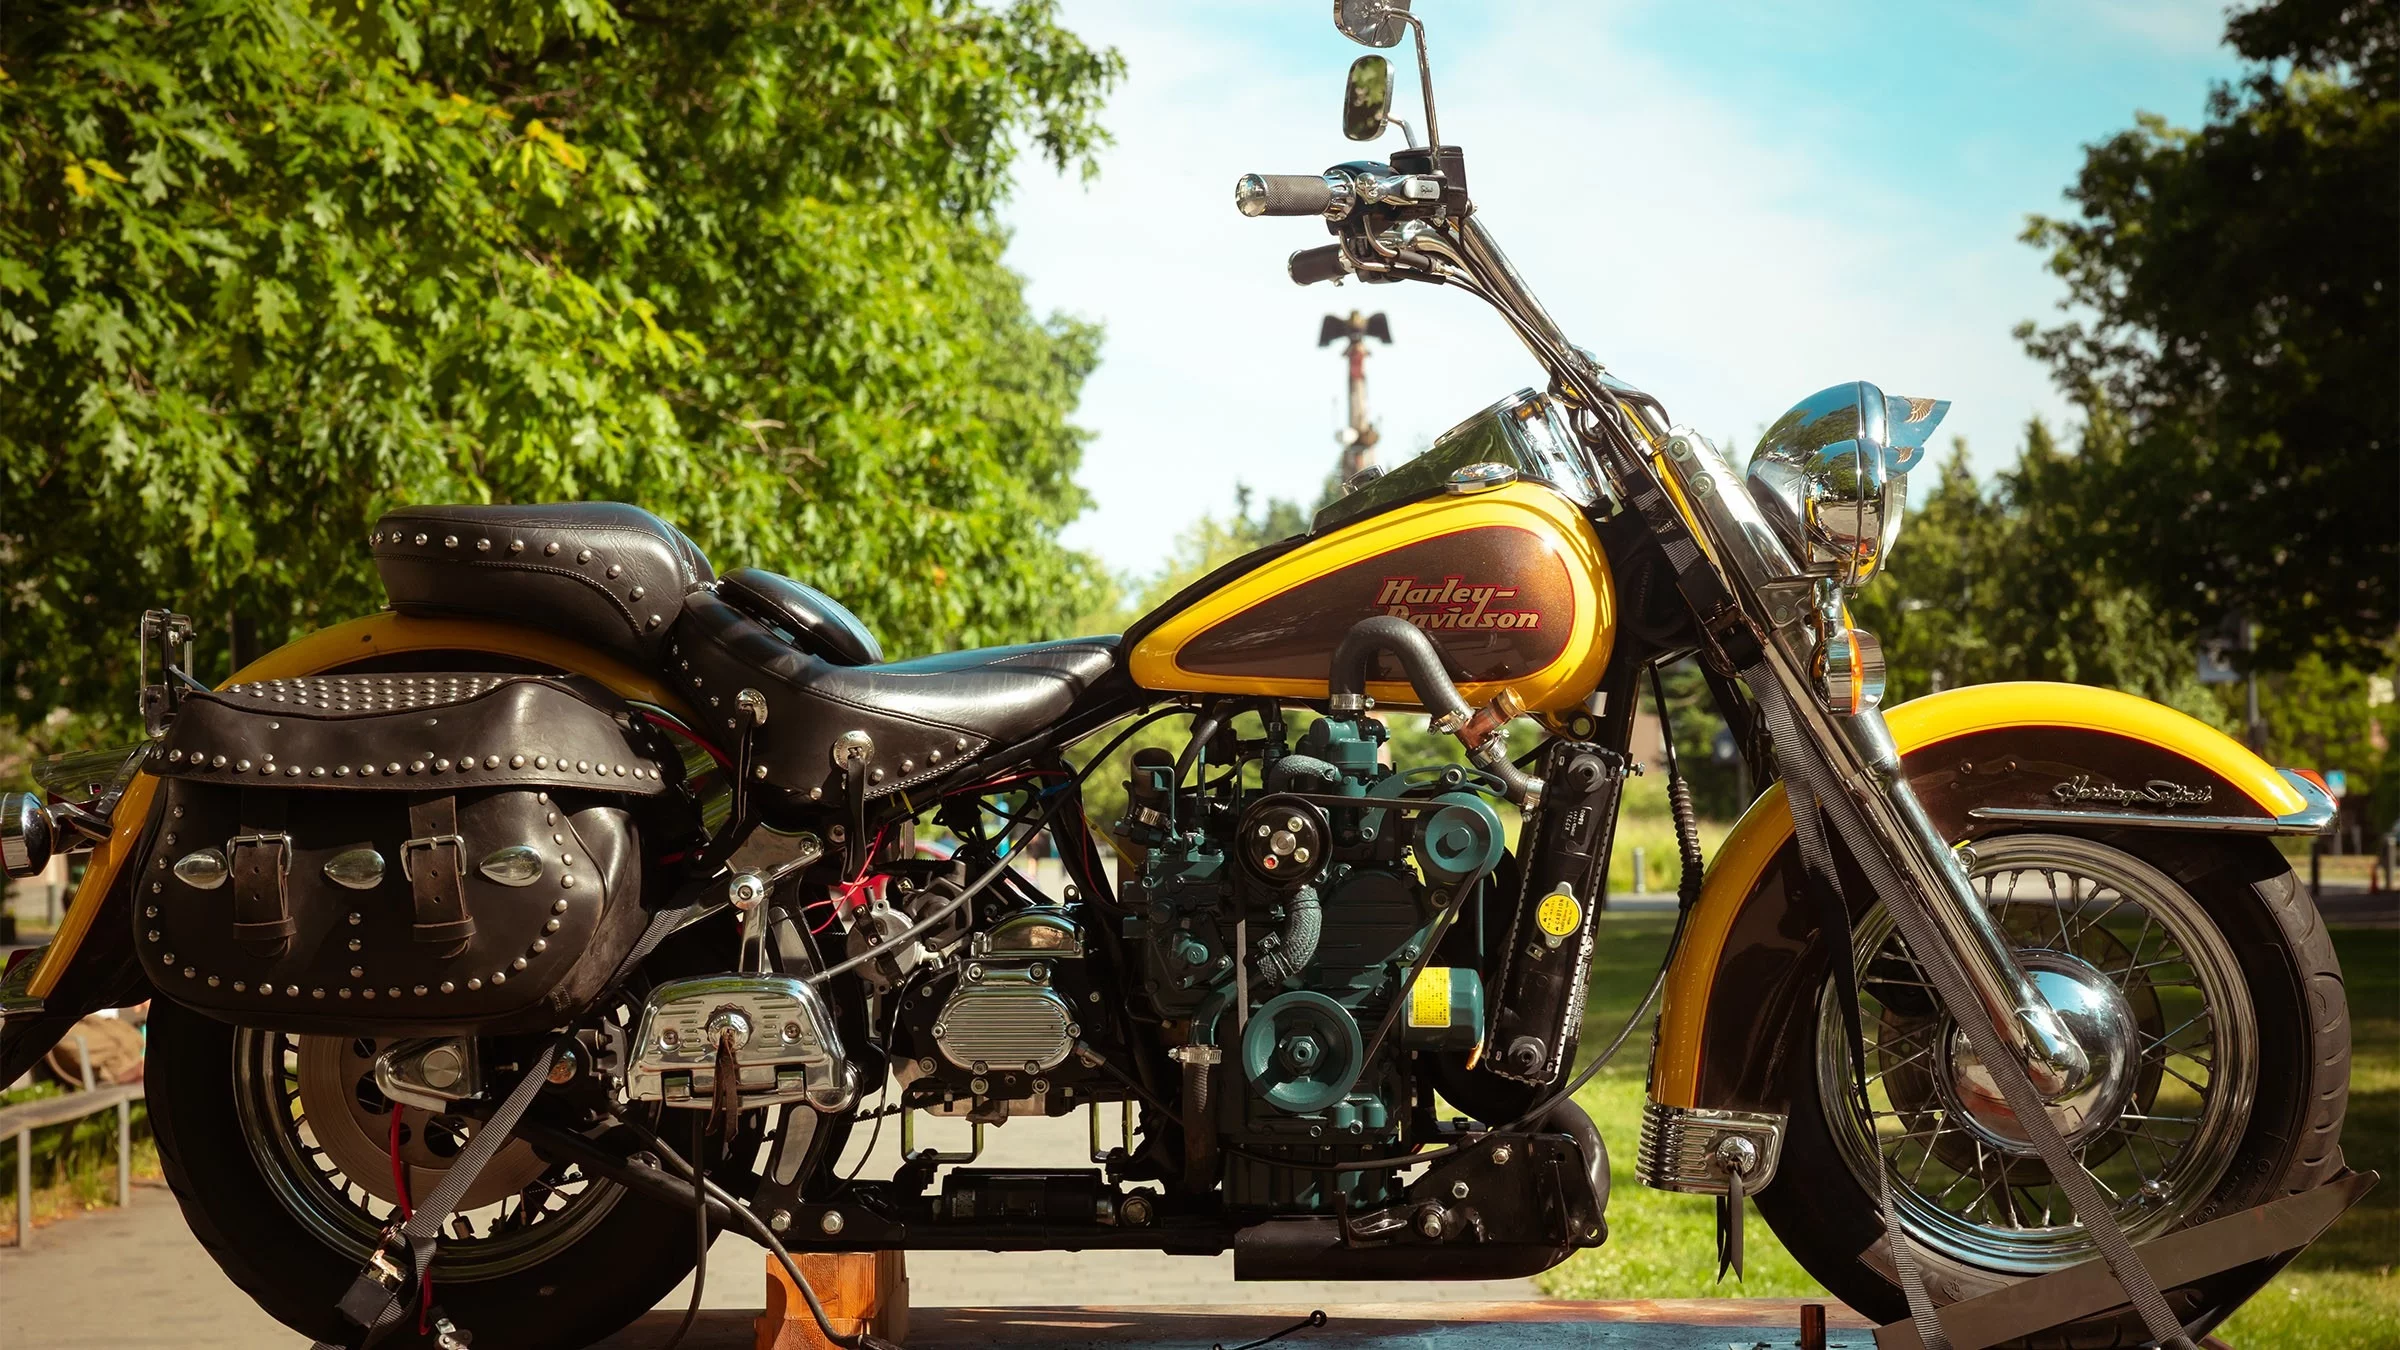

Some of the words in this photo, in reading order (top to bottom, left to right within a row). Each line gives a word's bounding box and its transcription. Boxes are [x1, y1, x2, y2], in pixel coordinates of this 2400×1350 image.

[1376, 577, 1518, 607] Harley-
[2052, 775, 2143, 806] Heritage
[2145, 779, 2212, 807] Softail
